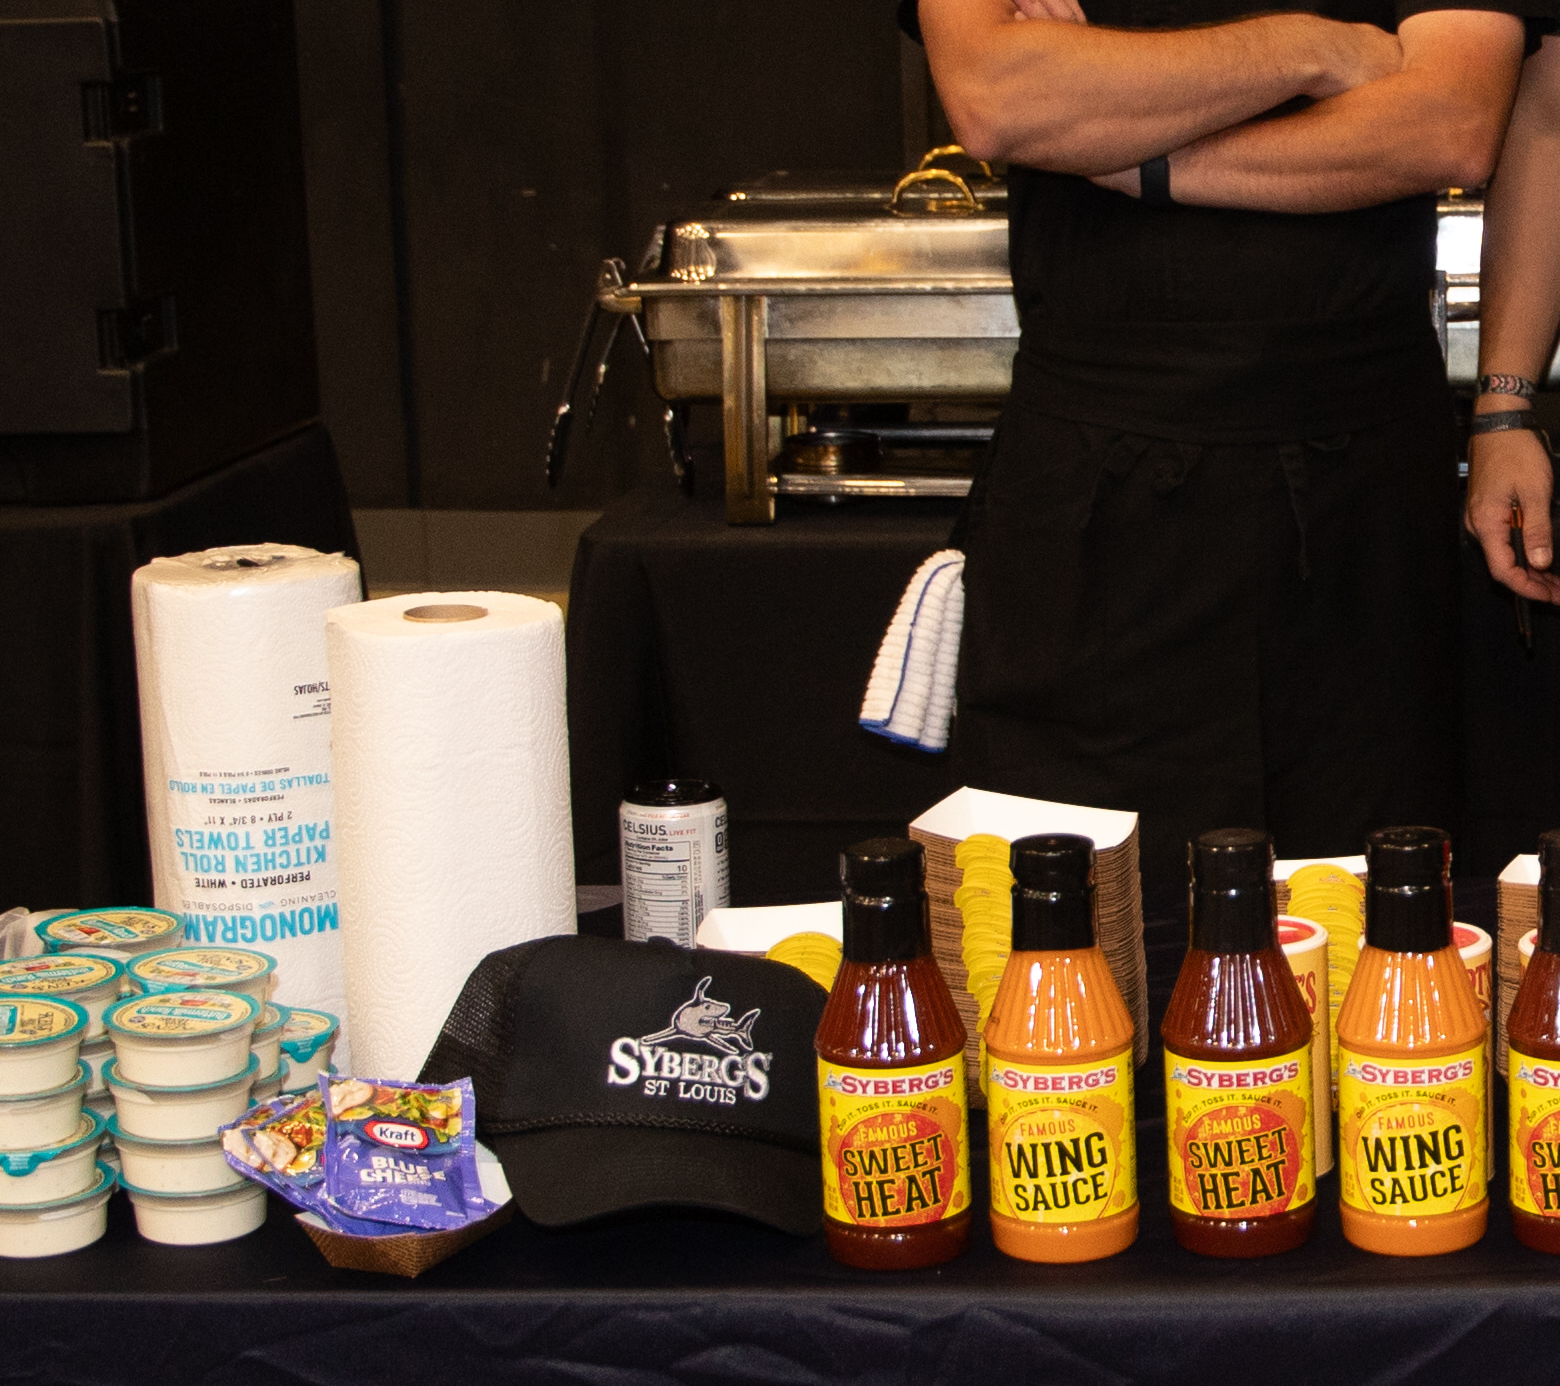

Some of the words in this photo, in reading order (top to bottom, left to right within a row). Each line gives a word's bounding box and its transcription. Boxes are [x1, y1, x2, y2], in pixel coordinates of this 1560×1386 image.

[201, 782, 214, 794] EN
[219, 781, 256, 794] PAPEL
[261, 781, 275, 792] DE
[280, 773, 330, 790] TOALLAS
[264, 820, 330, 848] PAPER
[623, 819, 666, 836] CELSIUS
[686, 828, 696, 836] FIT
[175, 828, 255, 851] TOWELS
[652, 844, 673, 852] Facts
[180, 851, 226, 873] ROLL
[235, 844, 326, 873] KITCHEN
[195, 877, 227, 889] WHITE
[241, 871, 311, 889] PERFORATED
[281, 890, 336, 907] CLEANING
[184, 902, 339, 944] MONOGRAM
[842, 1068, 953, 1094] SYBERG'S
[1004, 1068, 1116, 1091] SYBERG'S
[1187, 1063, 1298, 1088] SYBERG'S
[1362, 1060, 1473, 1084] SYBERG'S
[644, 1080, 669, 1095] ST
[679, 1082, 736, 1104] LOUIS
[1202, 1095, 1224, 1106] TOSS
[1241, 1094, 1272, 1104] SAUCE
[1376, 1091, 1399, 1103] TOSS
[1416, 1091, 1445, 1101] SAUCE
[857, 1103, 879, 1113] TOSS
[897, 1101, 927, 1111] SAUCE
[1018, 1097, 1039, 1108] TOSS
[1057, 1097, 1086, 1108] SAUCE
[1020, 1119, 1076, 1136] FAMOUS
[1204, 1114, 1261, 1134] FAMOUS
[1378, 1112, 1434, 1130] FAMOUS
[379, 1127, 417, 1142] Kraft
[860, 1122, 917, 1141] FAMOUS
[843, 1134, 942, 1176] SWEET
[1005, 1132, 1108, 1179] WING
[1188, 1127, 1287, 1168] SWEET
[1362, 1124, 1464, 1172] WING
[372, 1156, 428, 1174] BLUE
[852, 1165, 942, 1218] HEAT
[1014, 1171, 1108, 1211] SAUCE
[1197, 1159, 1286, 1210] HEAT
[1370, 1164, 1464, 1205] SAUCE
